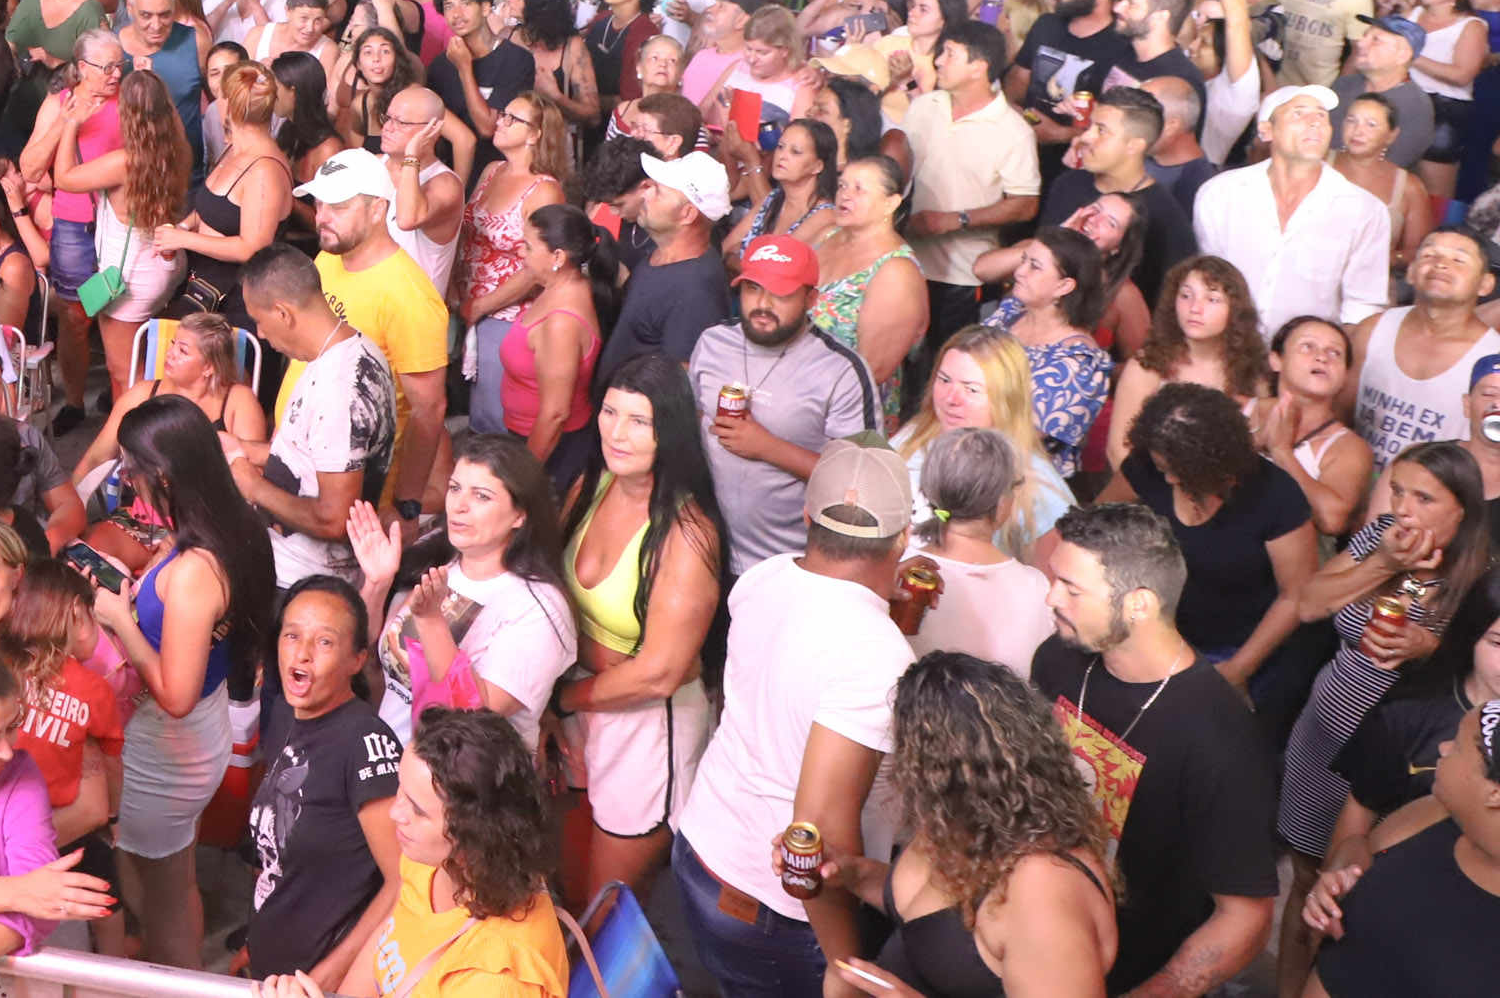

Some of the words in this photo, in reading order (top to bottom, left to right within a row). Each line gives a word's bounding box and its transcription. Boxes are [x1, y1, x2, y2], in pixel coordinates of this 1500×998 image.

[1363, 385, 1416, 420] MINHA
[1419, 407, 1446, 430] EX
[1380, 414, 1437, 442] BEM
[22, 707, 71, 749] IVIL
